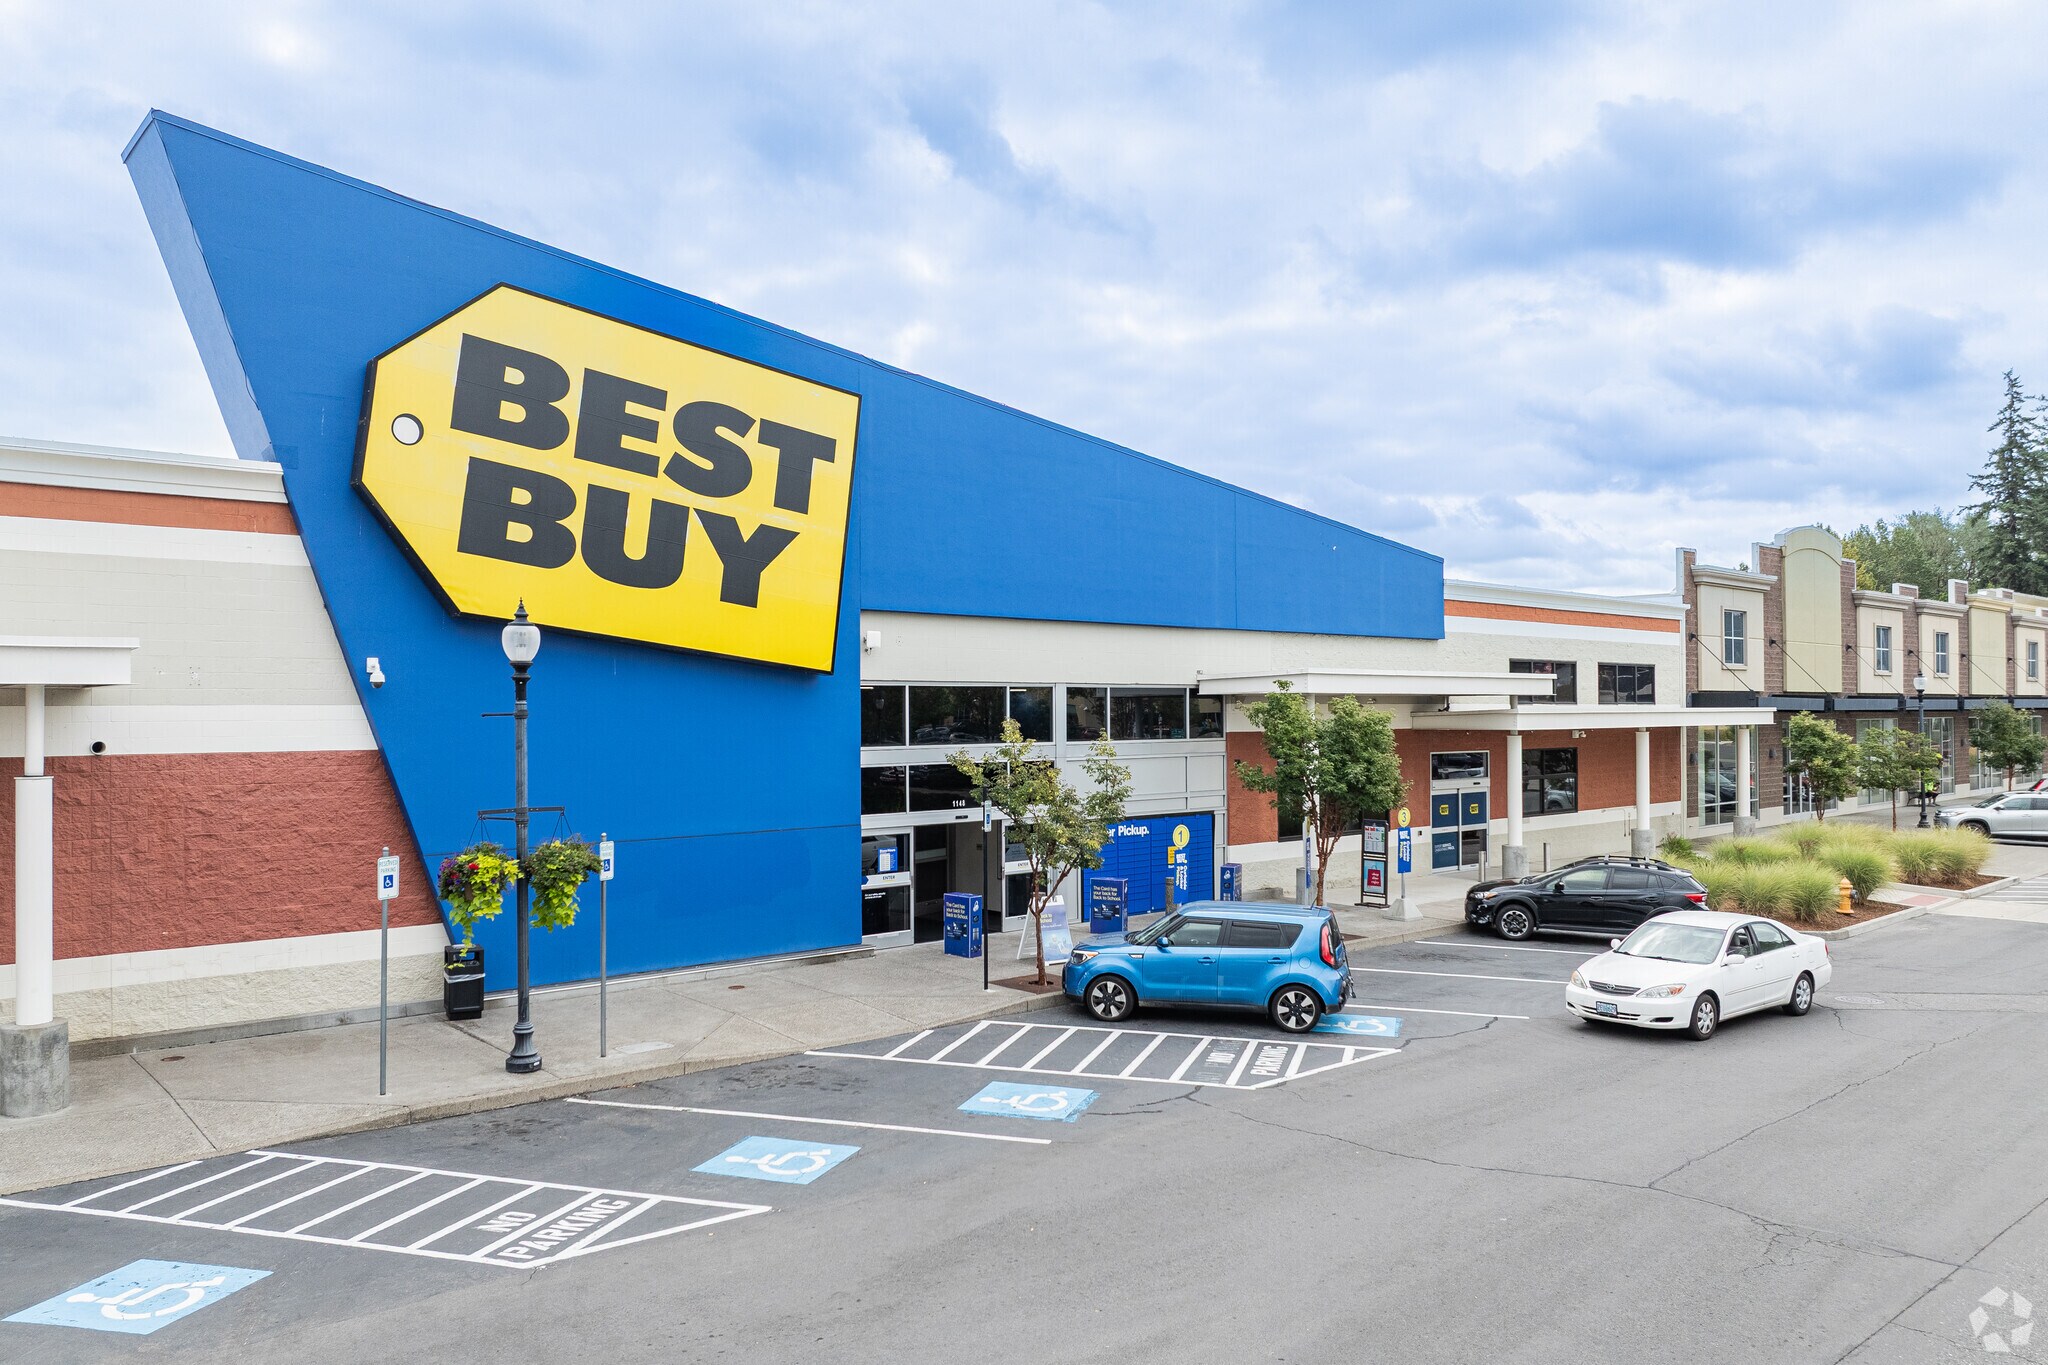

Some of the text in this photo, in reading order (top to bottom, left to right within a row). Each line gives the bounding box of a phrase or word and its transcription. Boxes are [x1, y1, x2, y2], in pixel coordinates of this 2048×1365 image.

[450, 333, 837, 515] BEST
[457, 455, 800, 609] BUY
[1402, 811, 1407, 823] 3
[1118, 825, 1150, 837] Pickup.
[1178, 830, 1183, 843] 1
[1206, 1052, 1236, 1064] NO
[1250, 1045, 1289, 1076] PARKING
[474, 1211, 537, 1233] NO
[497, 1199, 632, 1260] PARKING
